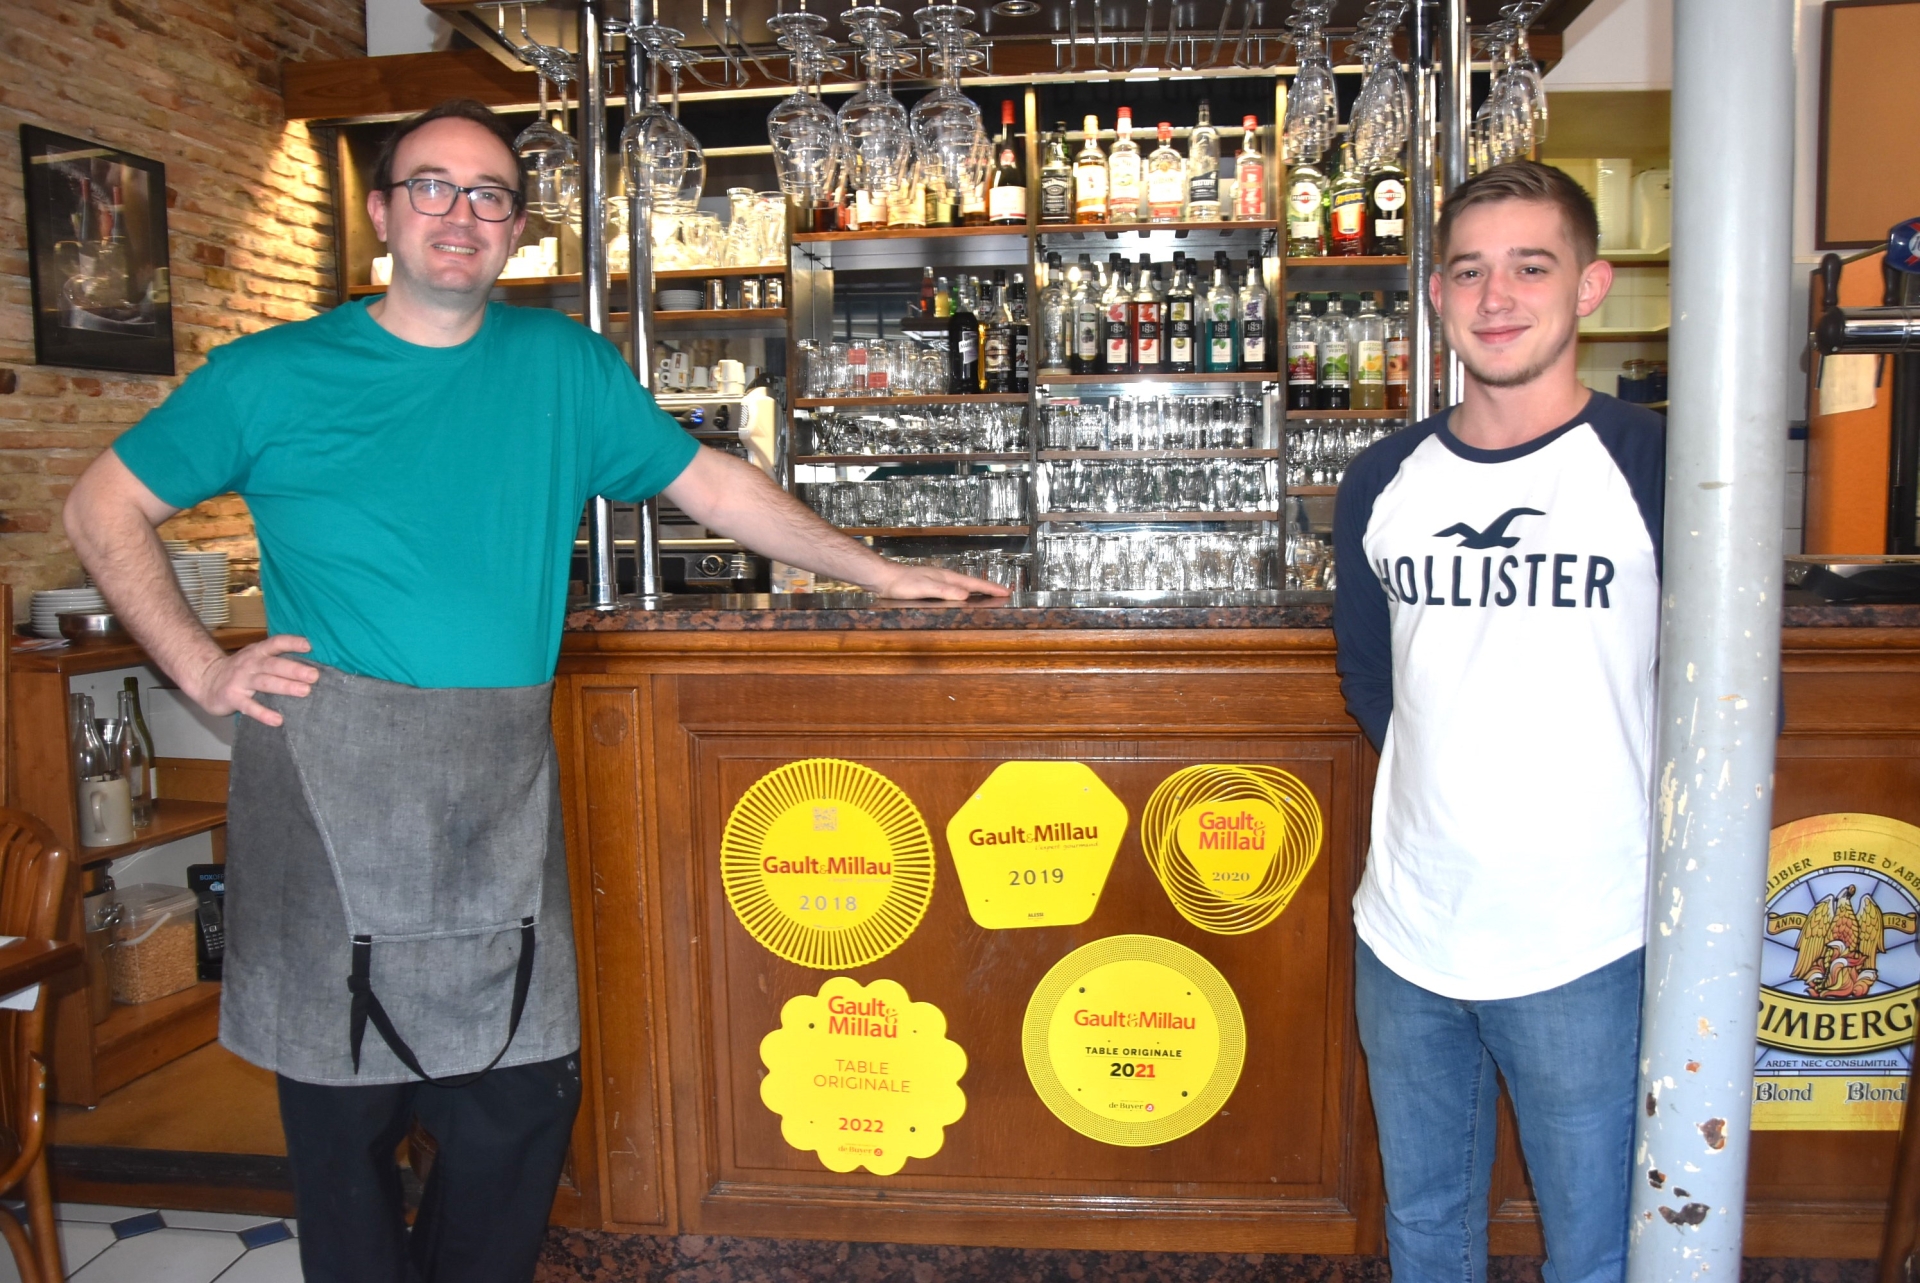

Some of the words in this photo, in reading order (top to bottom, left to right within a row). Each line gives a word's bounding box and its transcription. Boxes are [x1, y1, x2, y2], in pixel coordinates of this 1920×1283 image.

[1376, 554, 1614, 608] HOLLISTER
[1199, 831, 1265, 850] Millau
[1008, 868, 1064, 885] 2019
[1212, 871, 1250, 881] 2020
[1833, 848, 1876, 864] BIÈRE
[1881, 857, 1920, 891] D'ABB
[799, 895, 858, 911] 2018
[1774, 916, 1802, 930] ANNO
[1887, 916, 1907, 928] 1128
[829, 1016, 898, 1038] Millau
[1758, 998, 1919, 1041] IMBERG
[1085, 1047, 1119, 1055] TABLE
[1122, 1048, 1182, 1058] ORIGINALE
[835, 1059, 889, 1075] TABLE
[1110, 1062, 1156, 1078] 2021
[1765, 1060, 1798, 1068] ARDET
[1801, 1060, 1822, 1068] NEC
[1825, 1060, 1898, 1068] CONSUMITUR
[813, 1074, 911, 1093] ORIGINALE
[1754, 1081, 1813, 1103] Blond
[1846, 1081, 1908, 1103] Blond
[838, 1117, 884, 1133] 2022
